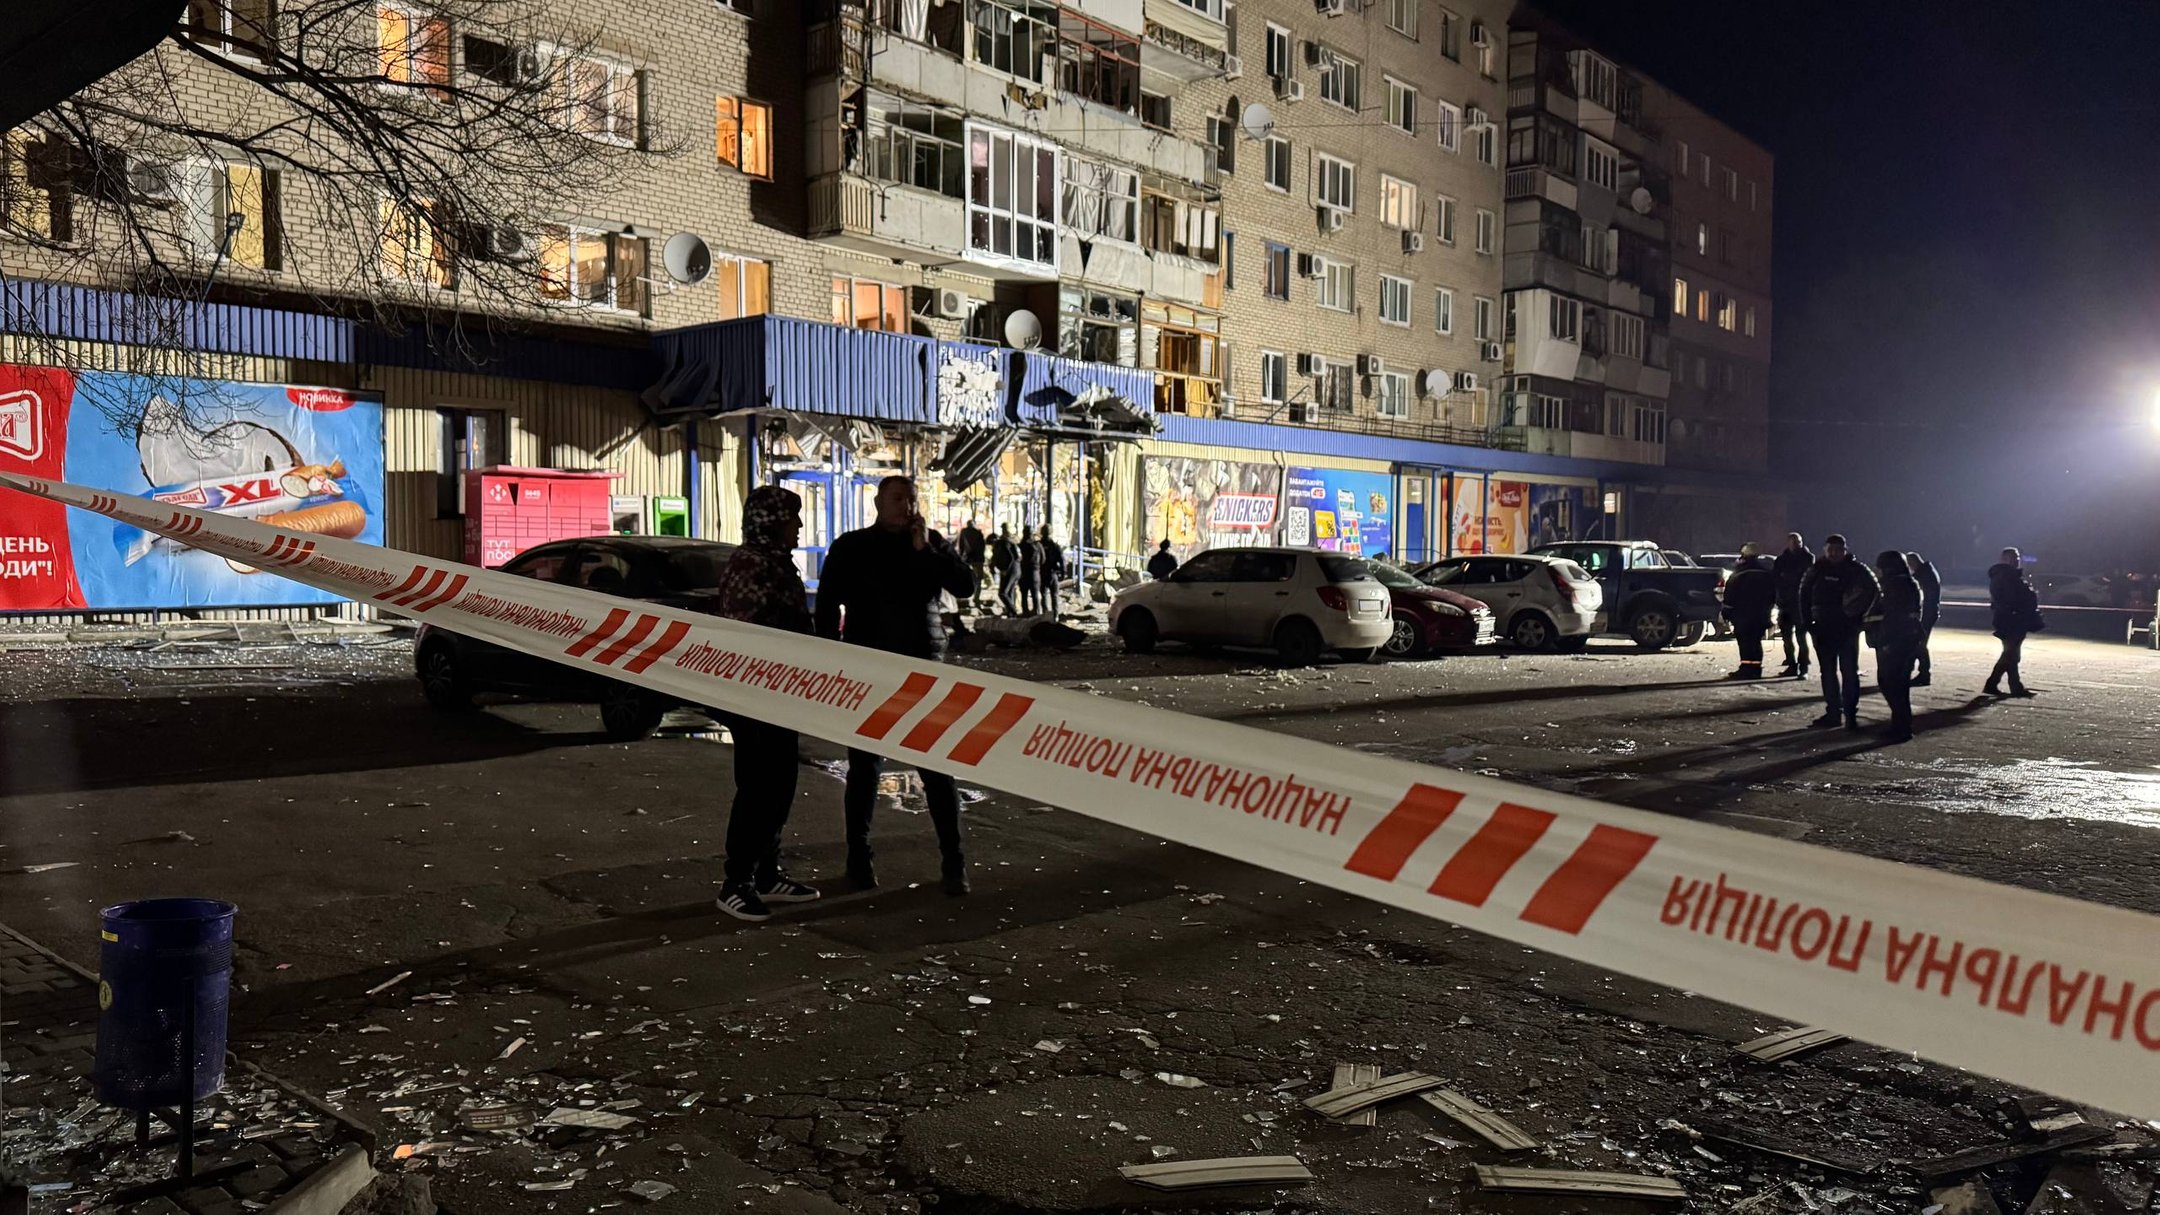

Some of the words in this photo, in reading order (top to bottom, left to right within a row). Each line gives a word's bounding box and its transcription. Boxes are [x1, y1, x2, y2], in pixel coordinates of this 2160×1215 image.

[220, 479, 282, 505] XL
[1214, 497, 1273, 522] SNICKERS
[487, 540, 510, 550] ТУТ
[487, 550, 516, 561] ПОС
[675, 640, 749, 680] ПОЛІЦІЯ
[739, 657, 873, 711] НАЦІОНАЛЬНА
[1022, 720, 1132, 778] ПОЛІЦІЯ
[1130, 747, 1352, 836] НАЦІОНАЛЬНА
[1659, 873, 1873, 973] ПОЛІЦІЯ
